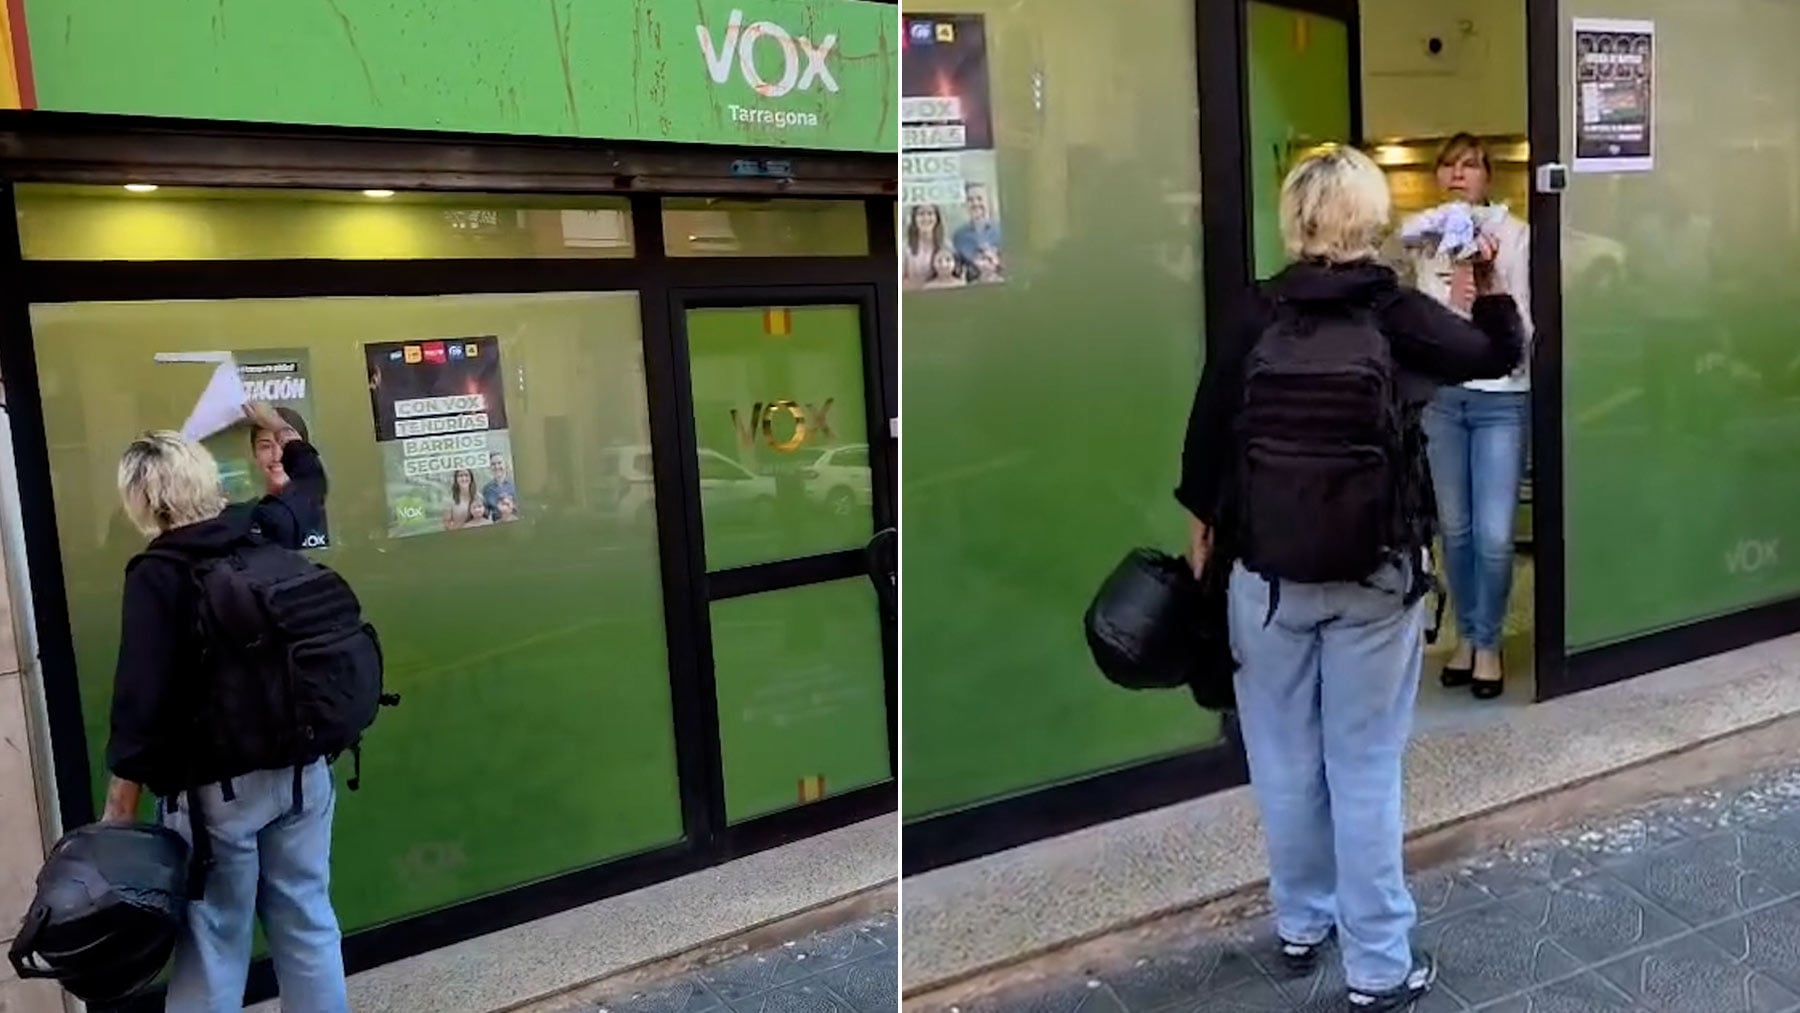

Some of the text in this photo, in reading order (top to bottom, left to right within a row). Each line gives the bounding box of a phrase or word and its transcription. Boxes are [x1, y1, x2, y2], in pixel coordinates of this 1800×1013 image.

[695, 8, 839, 97] VOX
[728, 104, 818, 128] Tarragona
[400, 397, 479, 414] CON VOX
[730, 398, 836, 453] VOX
[406, 435, 484, 454] BARRIOS
[406, 453, 488, 473] SEGUROS
